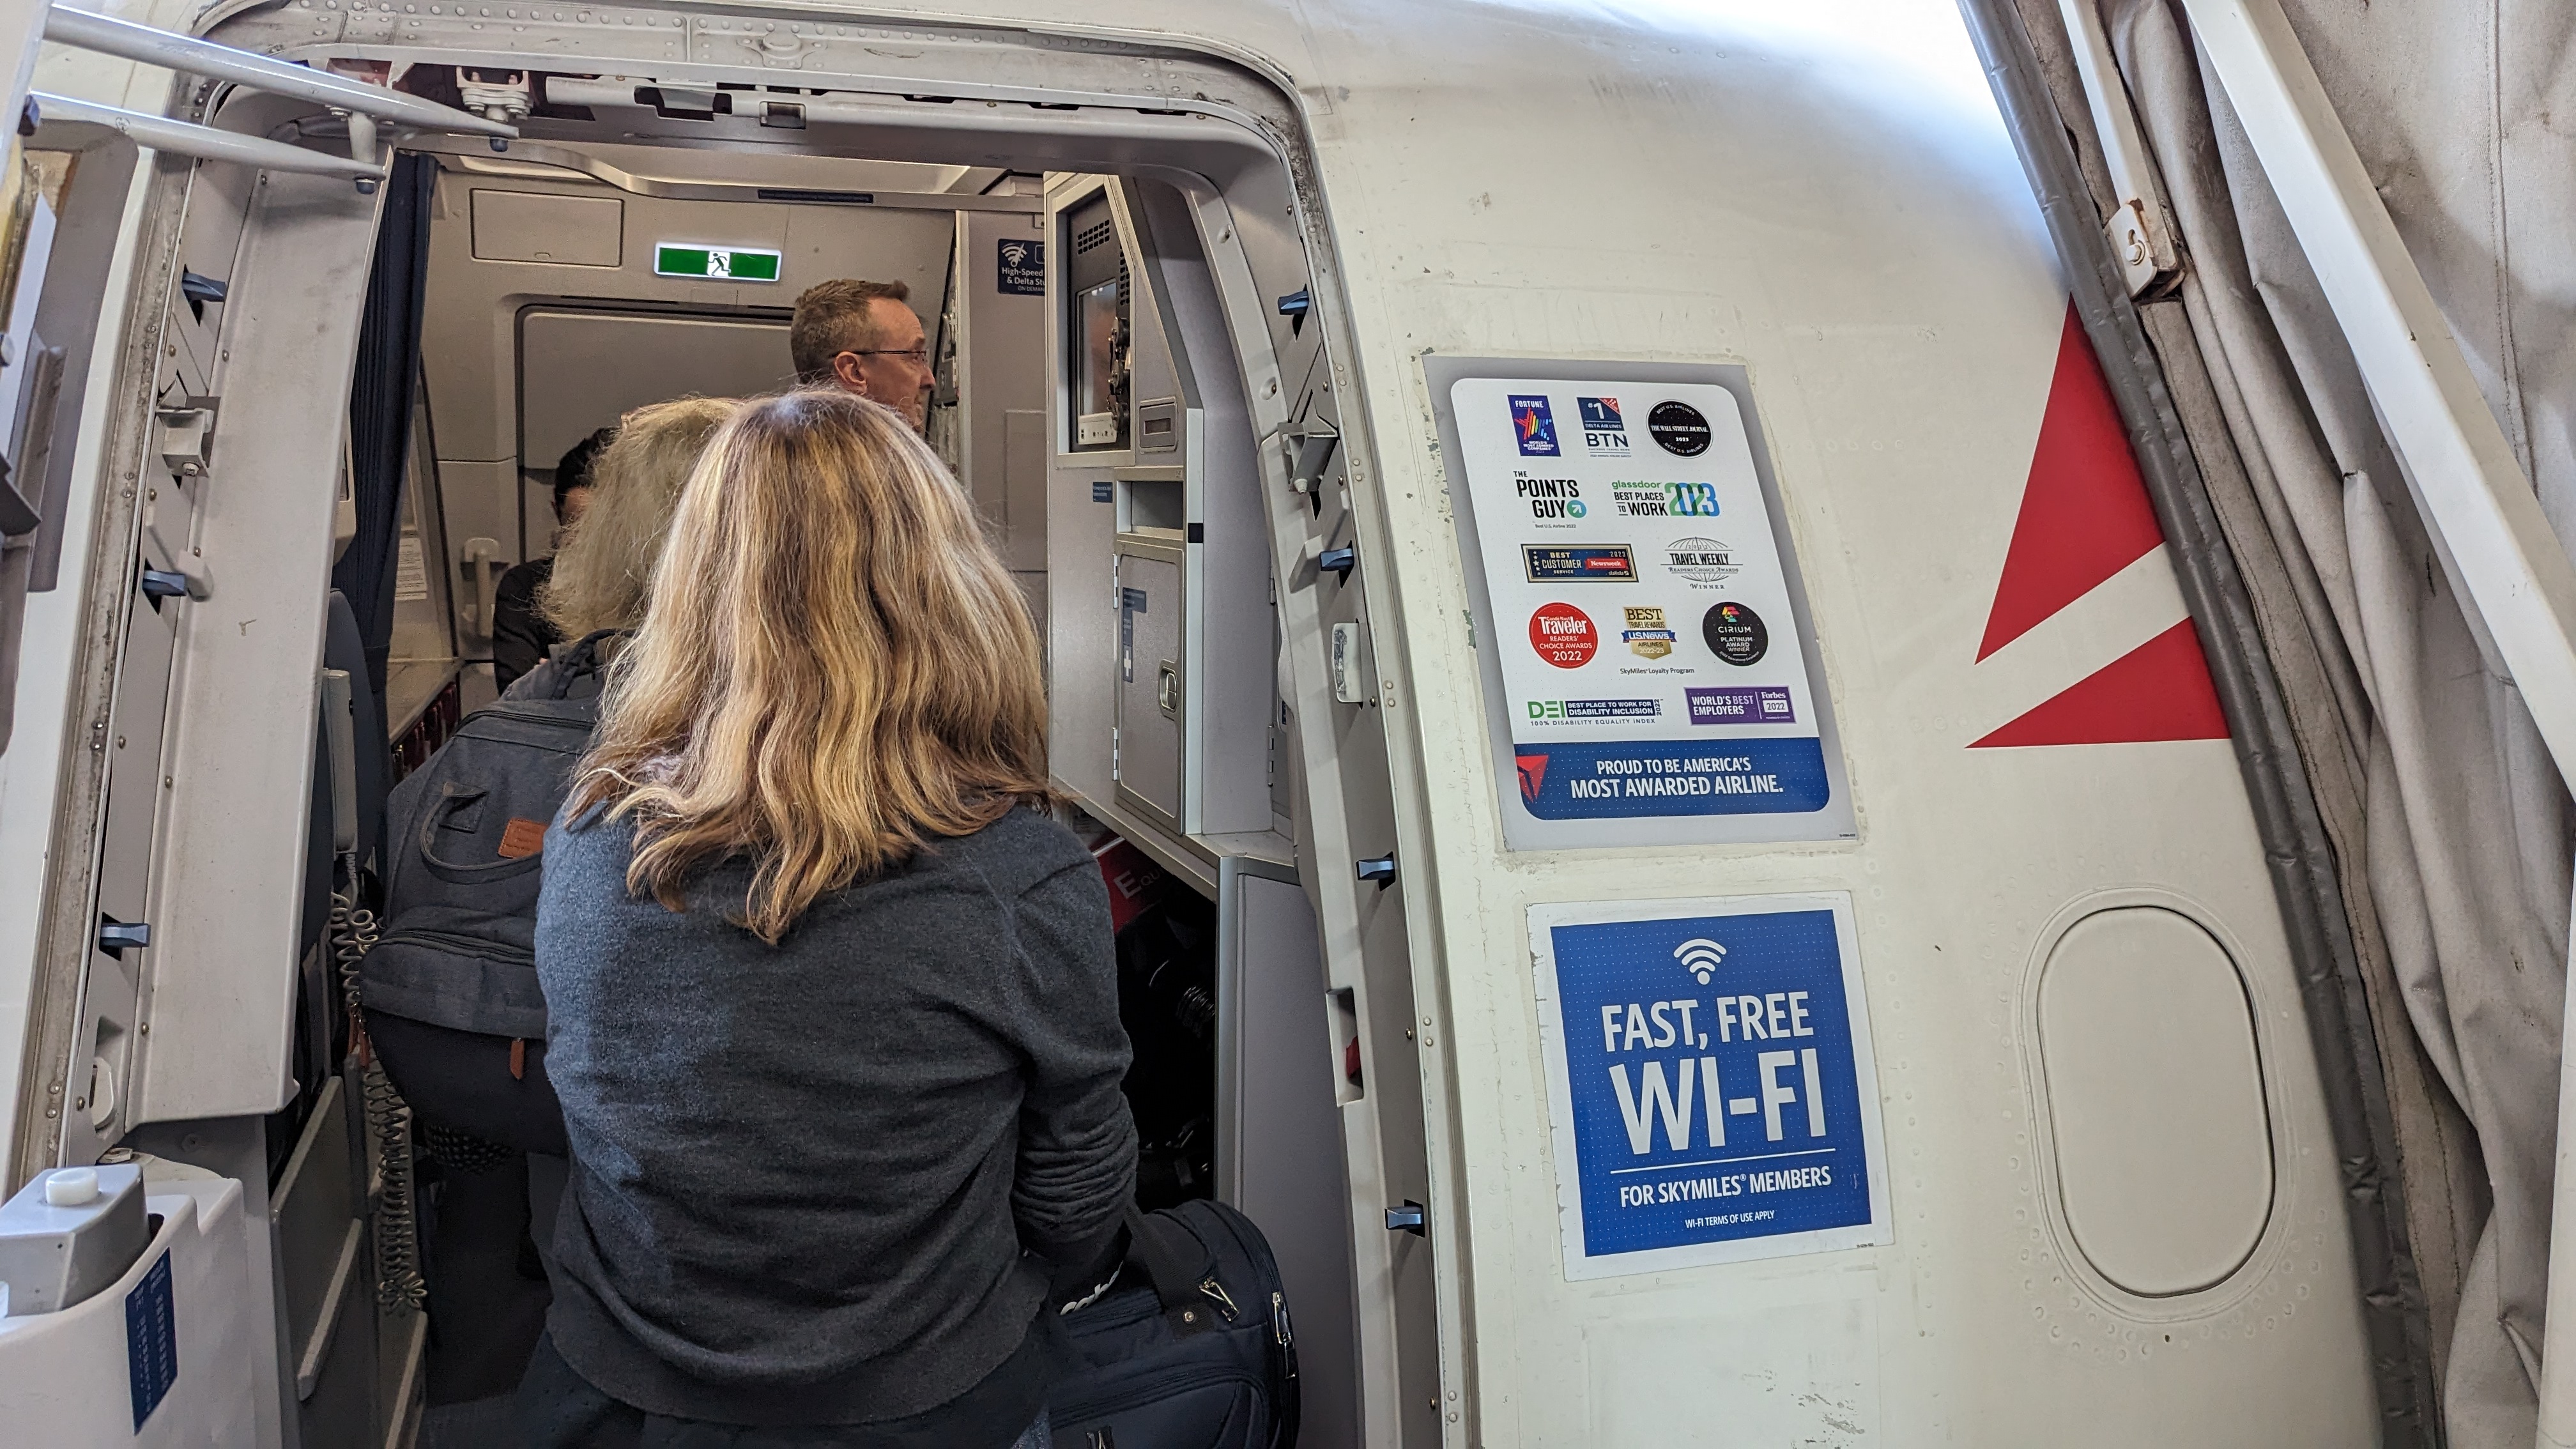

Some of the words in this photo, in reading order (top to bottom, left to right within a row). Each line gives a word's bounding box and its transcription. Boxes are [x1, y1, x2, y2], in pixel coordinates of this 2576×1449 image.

[1002, 267, 1043, 277] High-Speed
[1015, 277, 1034, 286] Delta
[1585, 433, 1629, 447] BTN
[1516, 479, 1579, 498] POINTS
[1611, 480, 1661, 489] glassdoor
[1614, 492, 1633, 501] BEST
[1635, 492, 1664, 501] PLACES
[1664, 482, 1721, 517] 2023
[1532, 500, 1565, 518] GUY
[1627, 502, 1669, 516] WORK
[1542, 559, 1581, 569] CUSTOMER
[1669, 553, 1699, 565] TRAVEL
[1699, 553, 1729, 565] WEEKLY
[1625, 609, 1662, 620] BEST
[1538, 616, 1587, 634] Traveler
[1552, 650, 1582, 661] 2022
[1692, 696, 1731, 706] WORLD'S
[1732, 695, 1754, 705] BEST
[1766, 702, 1786, 710] 2022
[1528, 700, 1566, 718] DEI
[1693, 705, 1744, 716] EMPLOYERS
[1596, 760, 1643, 775] PROUD
[1644, 760, 1662, 774] TO
[1665, 759, 1682, 774] BE
[1683, 757, 1751, 772] AMERICA'S
[1571, 778, 1623, 799] MOST
[1625, 776, 1710, 797] AWARDED
[1713, 774, 1784, 795] AIRLINE.
[1602, 999, 1708, 1052] FAST,
[1716, 991, 1813, 1043] FREE
[1608, 1048, 1826, 1154] WI-FI
[1620, 1186, 1655, 1208] FOR
[1749, 1166, 1832, 1193] MEMBERS
[1685, 1218, 1704, 1228] WI-FI
[1705, 1215, 1729, 1227] TERMS
[1729, 1214, 1738, 1224] OF
[1739, 1212, 1753, 1223] USE
[1754, 1210, 1775, 1222] APPLY
